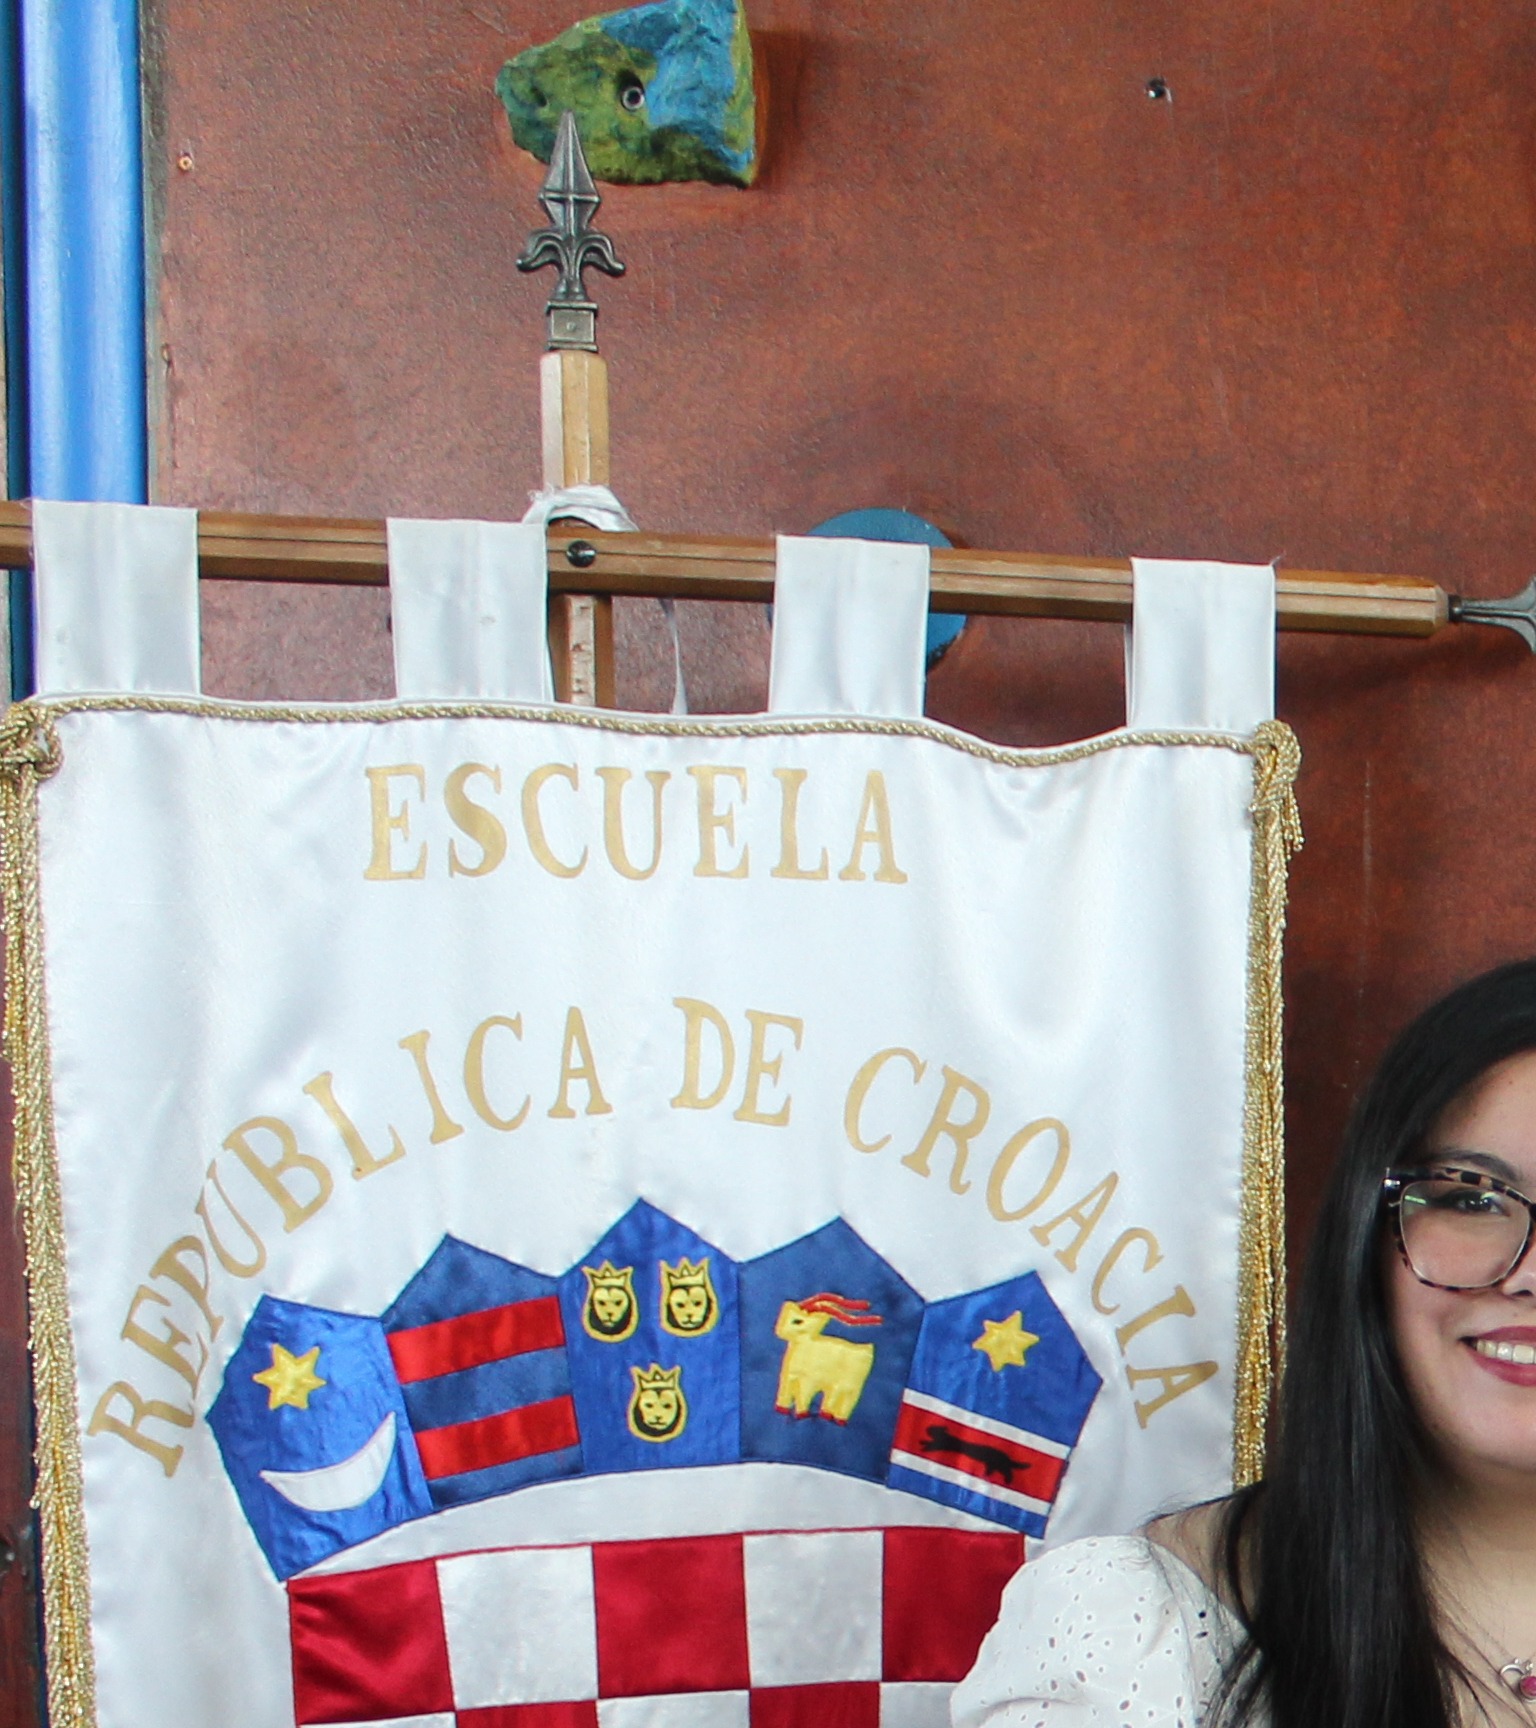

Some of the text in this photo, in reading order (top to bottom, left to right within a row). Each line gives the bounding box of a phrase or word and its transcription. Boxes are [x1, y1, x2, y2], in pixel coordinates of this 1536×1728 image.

[362, 762, 908, 885] ESCUELA
[86, 996, 1221, 1479] REPUBLICA DE CROACIA
